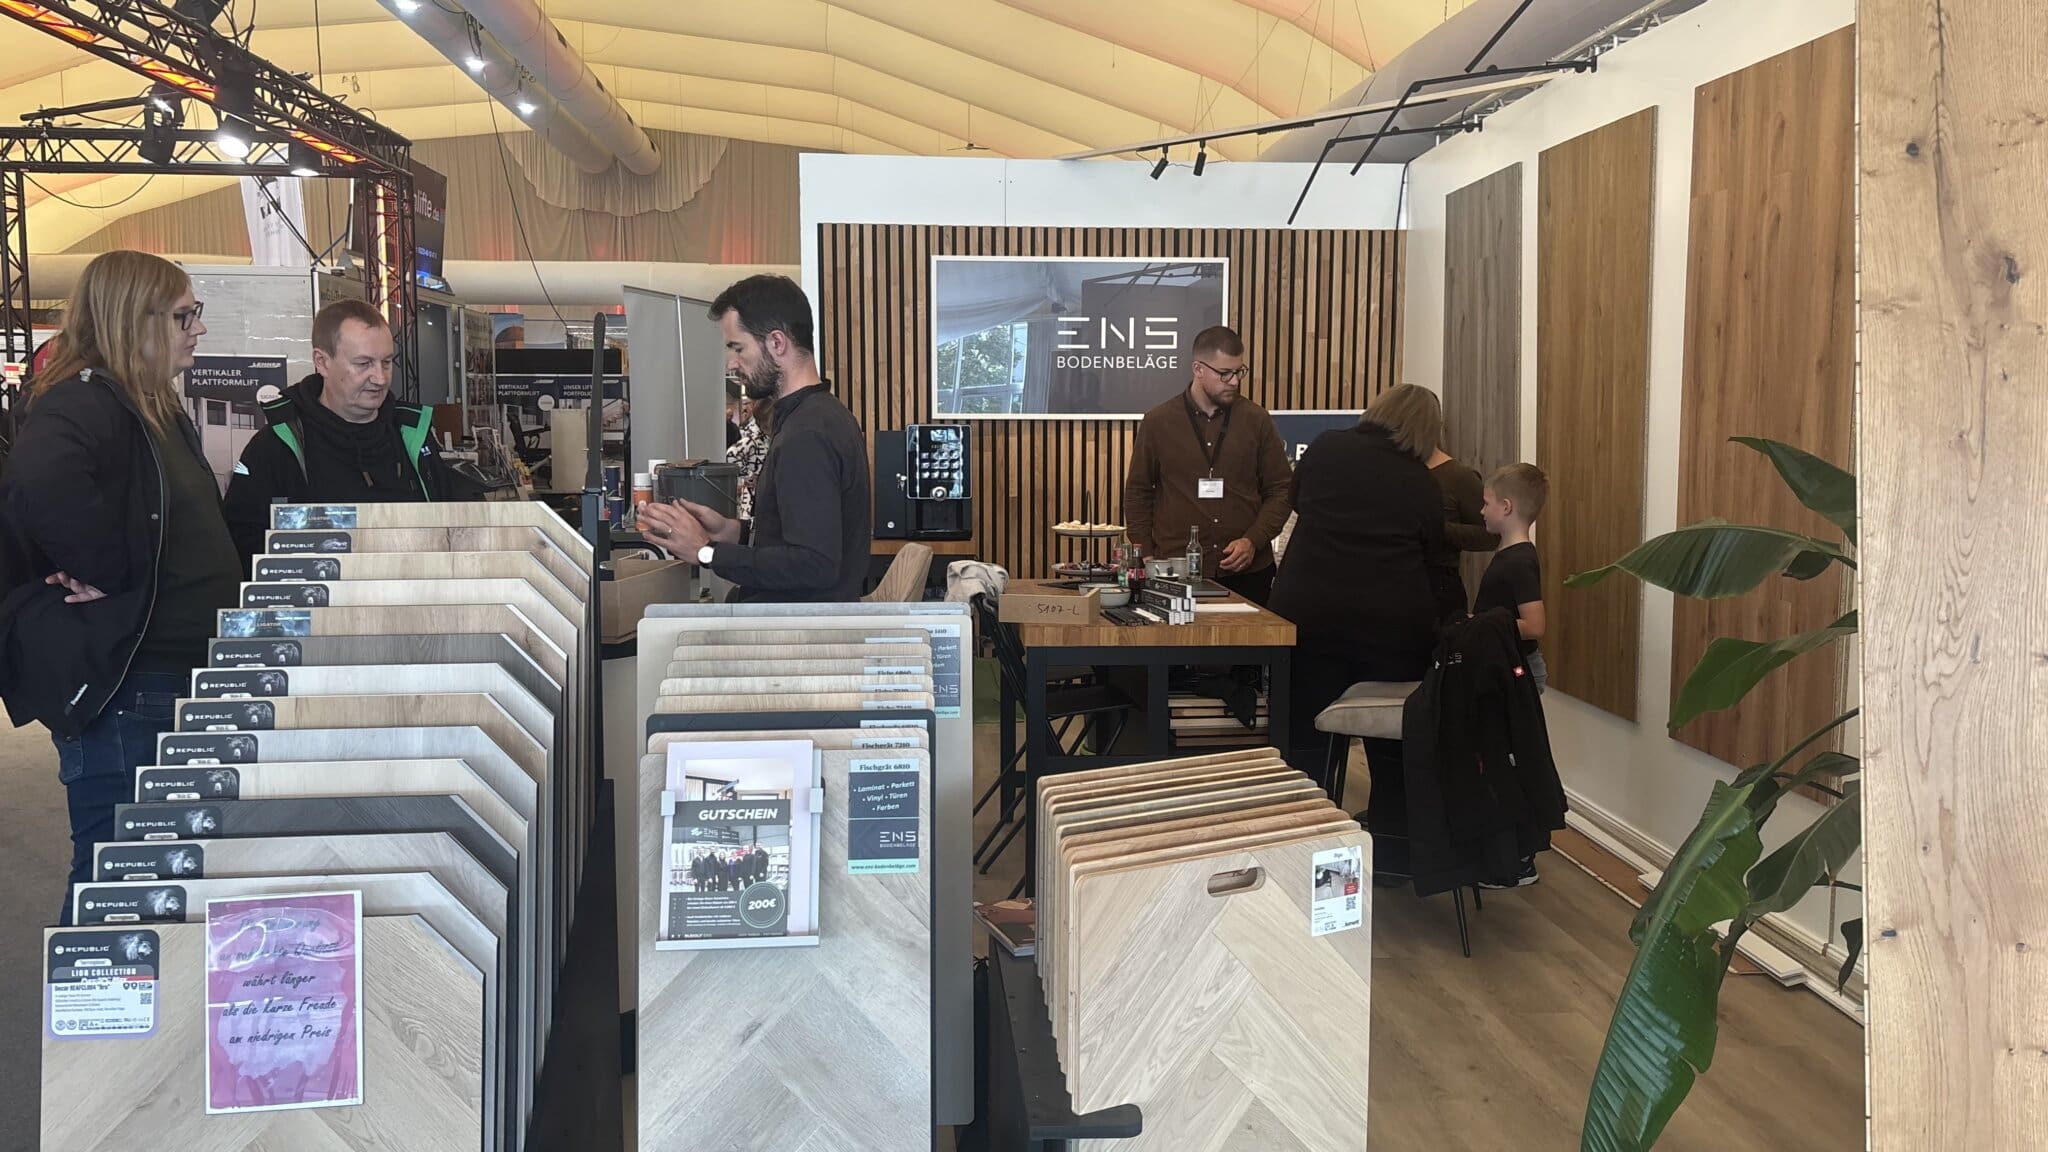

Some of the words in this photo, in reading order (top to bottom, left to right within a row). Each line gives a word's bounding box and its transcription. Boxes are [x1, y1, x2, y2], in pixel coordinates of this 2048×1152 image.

[1057, 317, 1178, 349] ENS
[1057, 353, 1178, 369] BODENBELÄGE
[191, 368, 242, 377] VERTIKALER
[191, 378, 259, 386] PLATTFORMLIFT
[859, 763, 892, 771] Fischgrät
[857, 784, 886, 793] Laminat
[891, 781, 916, 789] Parkett
[866, 794, 884, 803] Vinyl
[889, 792, 908, 800] Türen
[876, 803, 900, 811] Farben
[698, 808, 779, 821] GUTSCHEIN
[879, 830, 917, 842] ENS
[748, 898, 777, 911] 200€
[65, 945, 110, 953] REPUBLIC
[71, 968, 89, 977] LION
[91, 967, 137, 976] COLLECTION
[243, 973, 276, 987] währt
[280, 971, 316, 989] länger
[222, 1002, 240, 1016] als
[242, 1002, 258, 1015] die
[298, 996, 337, 1011] Freude
[229, 1035, 243, 1044] am
[247, 1029, 296, 1046] niedrigen
[301, 1024, 332, 1039] Preis
